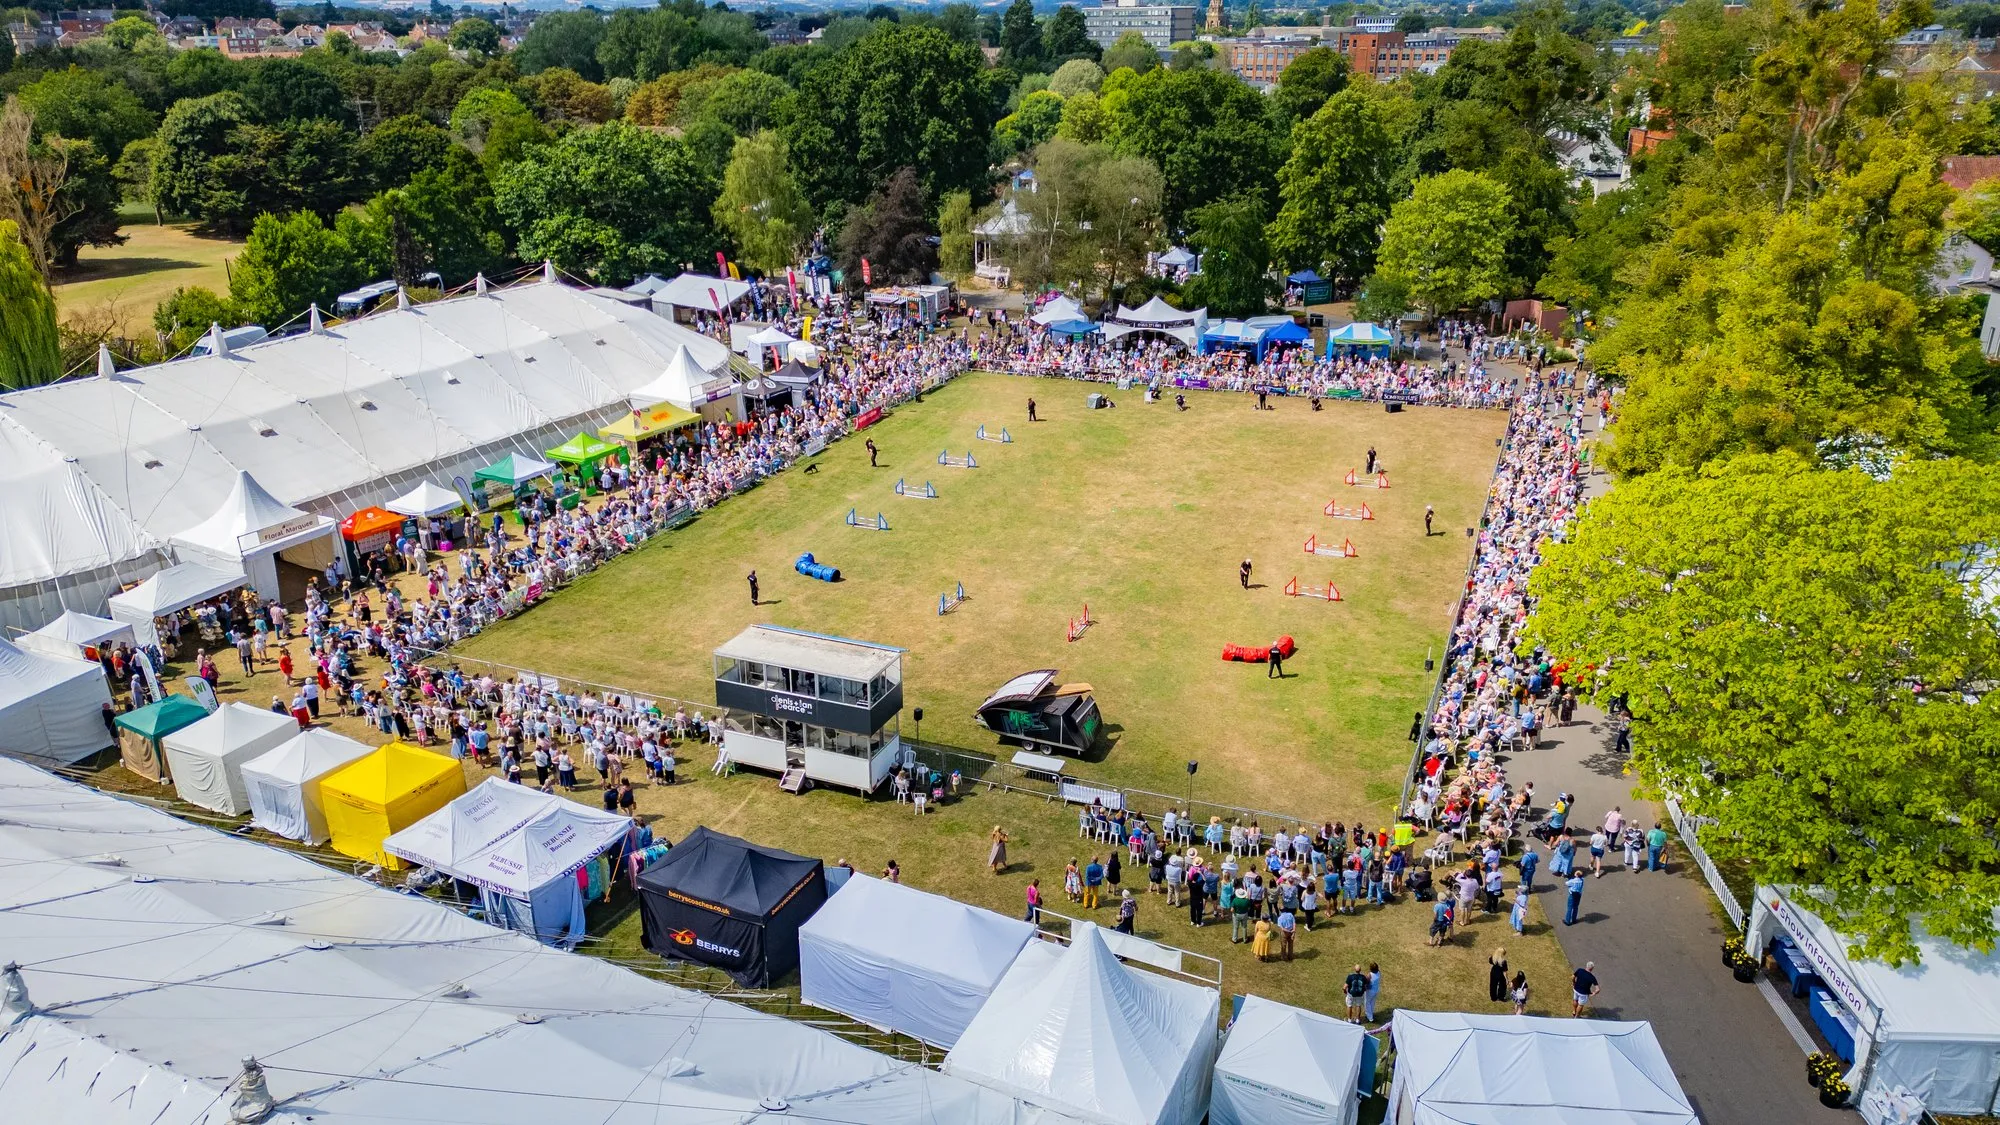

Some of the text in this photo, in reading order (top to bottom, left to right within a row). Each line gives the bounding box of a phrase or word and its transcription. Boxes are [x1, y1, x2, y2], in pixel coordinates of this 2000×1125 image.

[264, 520, 314, 540] Floral Marquee
[192, 681, 207, 695] WI
[775, 702, 806, 714] pearce
[463, 795, 494, 818] DEBUSSIE
[472, 804, 500, 823] Boutique
[542, 823, 575, 849] DEBUSSIE
[549, 831, 577, 853] Boutique
[396, 847, 438, 868] DEBUSSIE
[490, 853, 525, 872] DEBUSSIE
[488, 861, 517, 877] Boutique
[466, 874, 514, 896] DEBUSSIE
[770, 871, 816, 916] berryscoaches.co.uk
[668, 890, 731, 916] berryscoaches.co.uk
[696, 938, 741, 958] BERRYS
[1779, 906, 1863, 1012] Show Information
